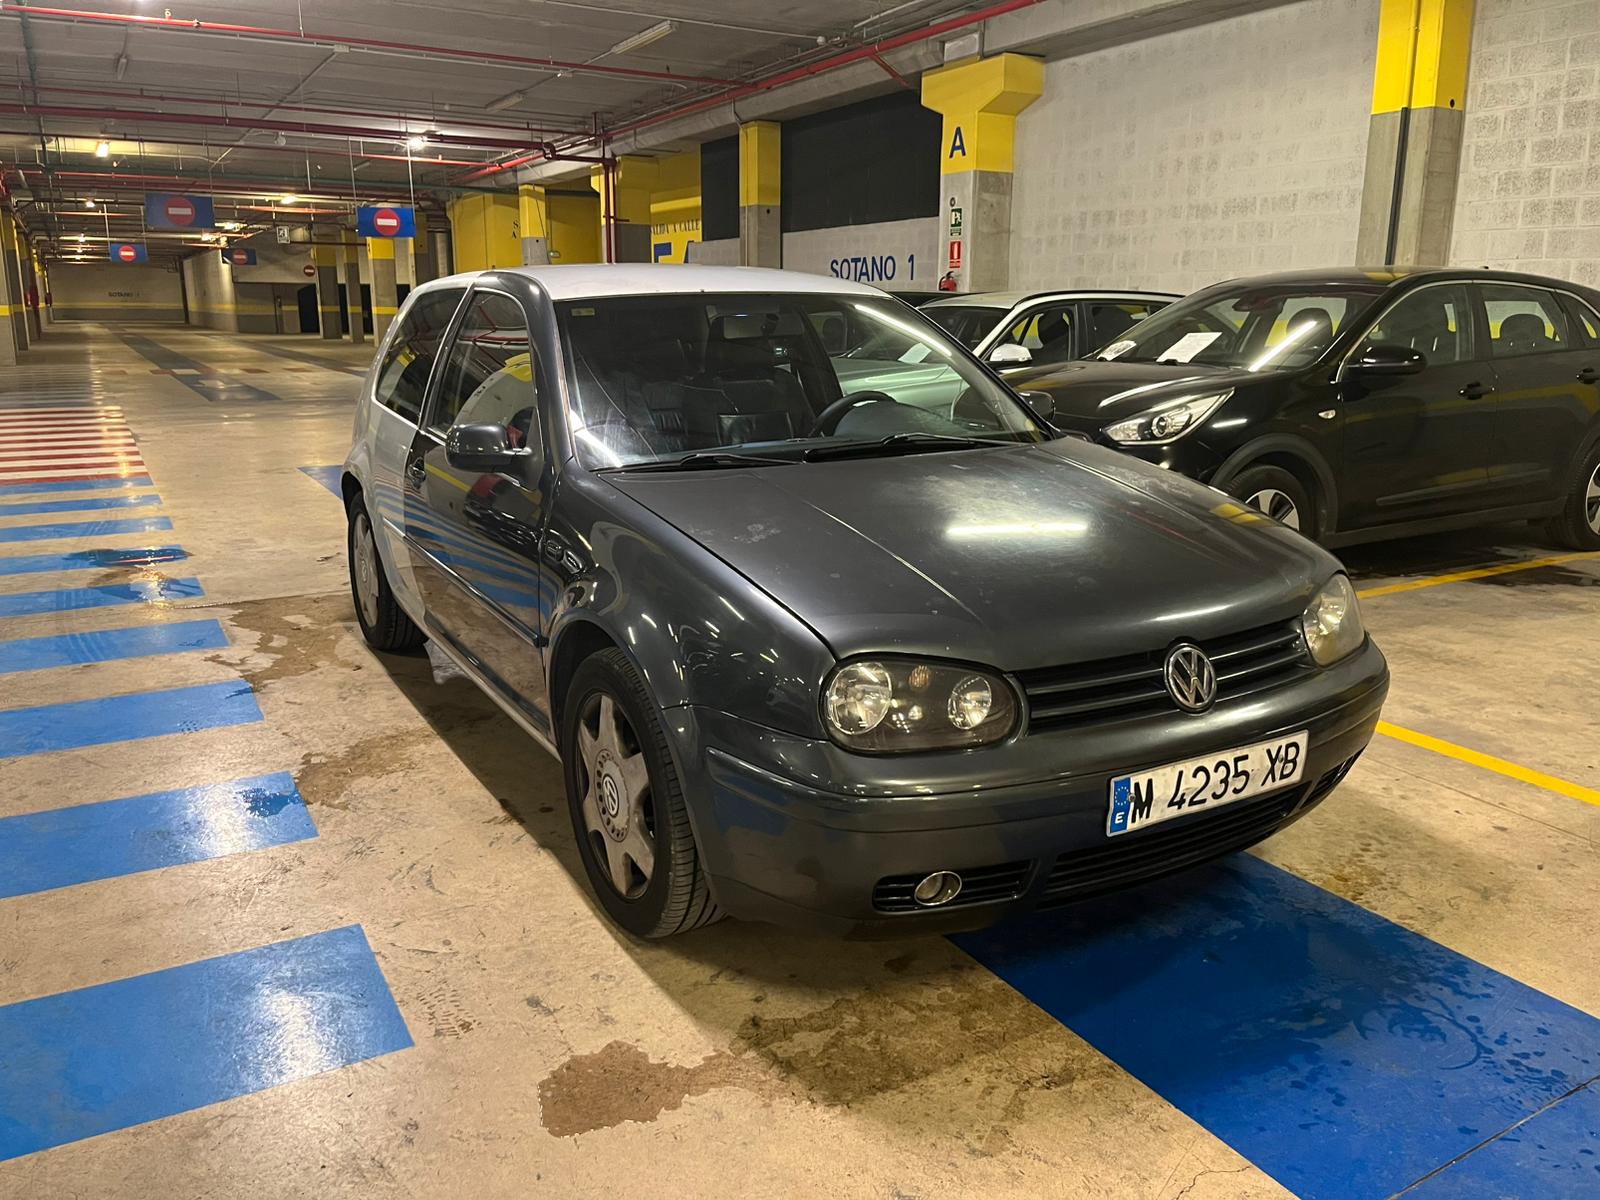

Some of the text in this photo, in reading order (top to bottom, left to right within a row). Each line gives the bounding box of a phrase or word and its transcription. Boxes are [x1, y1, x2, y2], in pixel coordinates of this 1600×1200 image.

[949, 126, 967, 158] A
[651, 223, 670, 235] ALIDA
[830, 253, 915, 283] SOTANO 1
[1131, 740, 1301, 824] M 4235 XB
[1114, 812, 1125, 824] E
